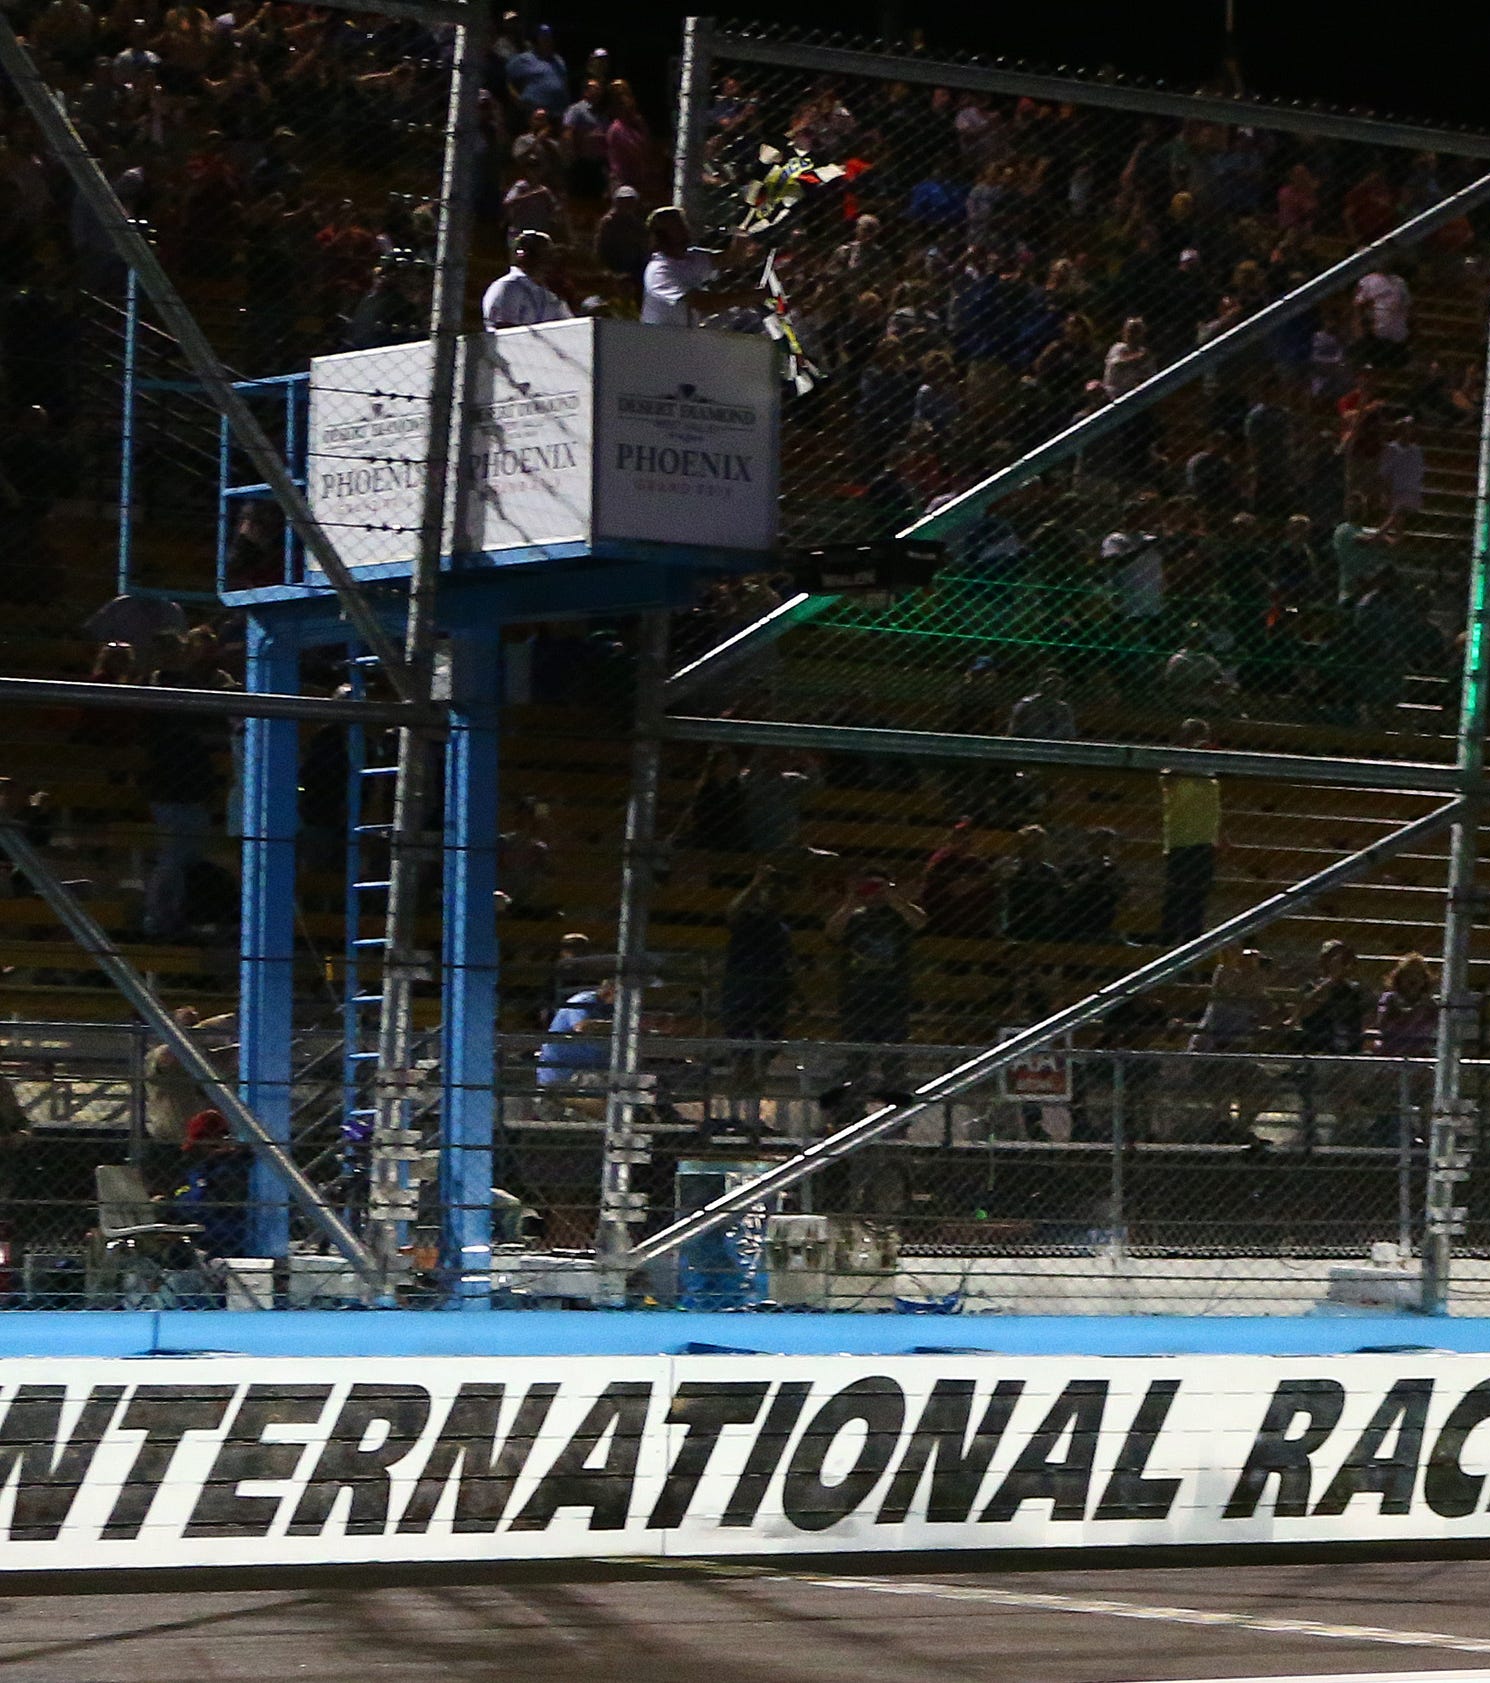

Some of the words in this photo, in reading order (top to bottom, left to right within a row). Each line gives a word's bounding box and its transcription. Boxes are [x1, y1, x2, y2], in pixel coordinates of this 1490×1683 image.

[469, 440, 578, 484] PHOENIX
[615, 442, 754, 484] PHOENIX
[0, 1375, 1182, 1541] NTERNATIONAL
